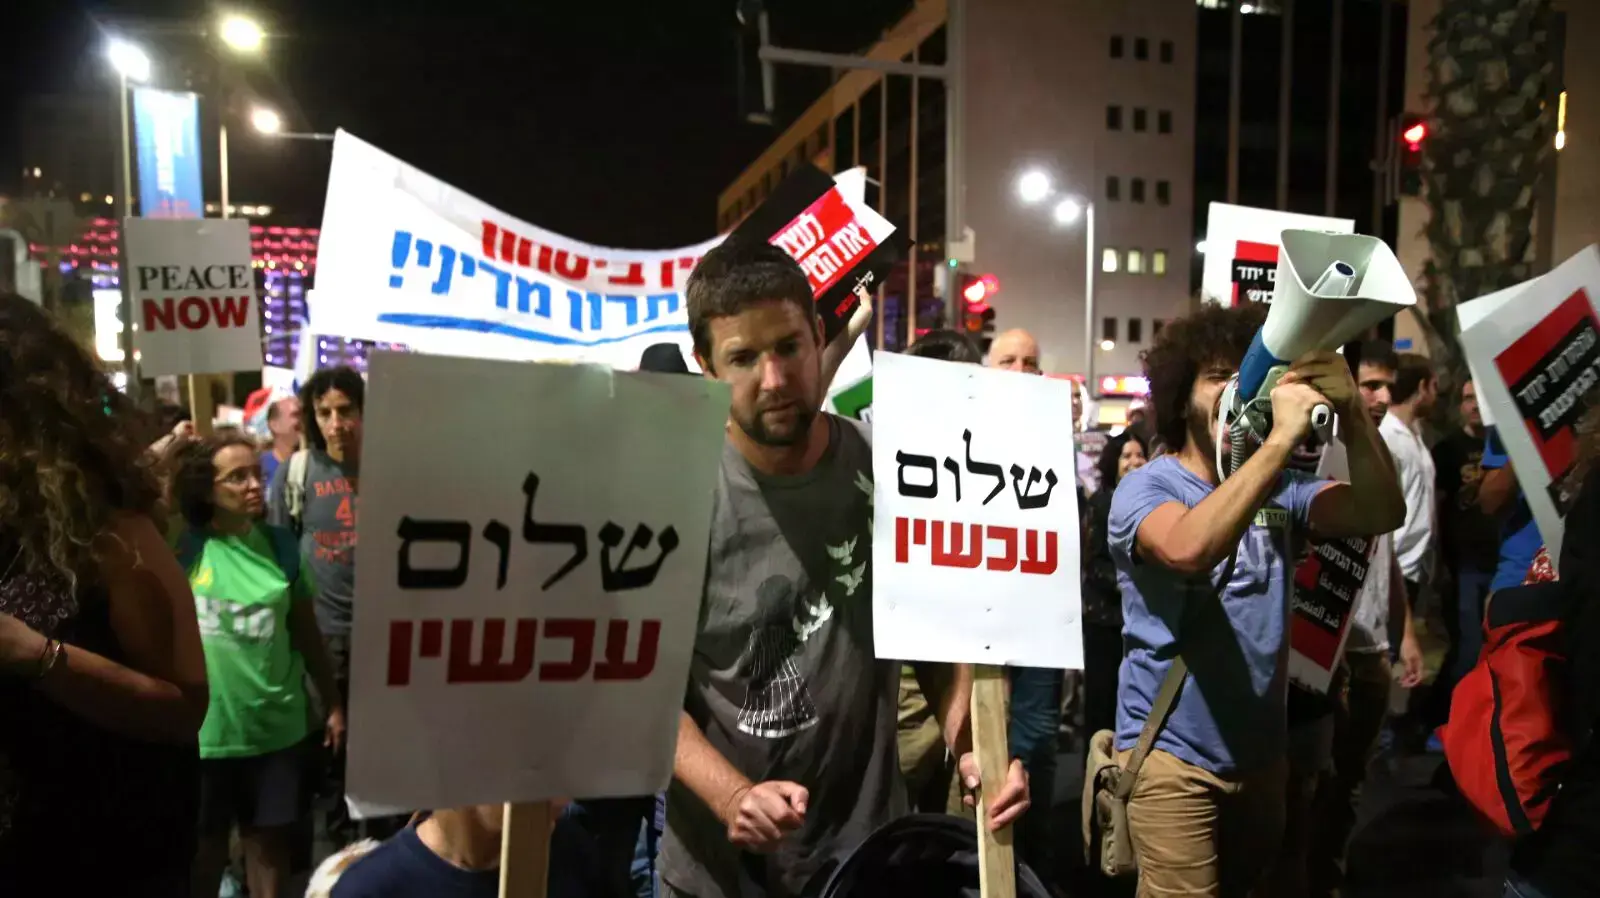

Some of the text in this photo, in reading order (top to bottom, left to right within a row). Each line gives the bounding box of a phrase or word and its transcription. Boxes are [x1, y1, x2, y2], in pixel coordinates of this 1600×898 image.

[482, 219, 704, 289] ין ביטחון
[830, 222, 870, 262] את
[1236, 265, 1264, 280] יחד
[137, 264, 250, 291] PEACE
[389, 229, 680, 332] תרון מדיני!
[142, 295, 249, 332] NOW
[896, 428, 1058, 510] שלום
[396, 470, 679, 592] שלום
[895, 516, 1058, 575] עכשיו
[386, 618, 661, 686] עכשיו
